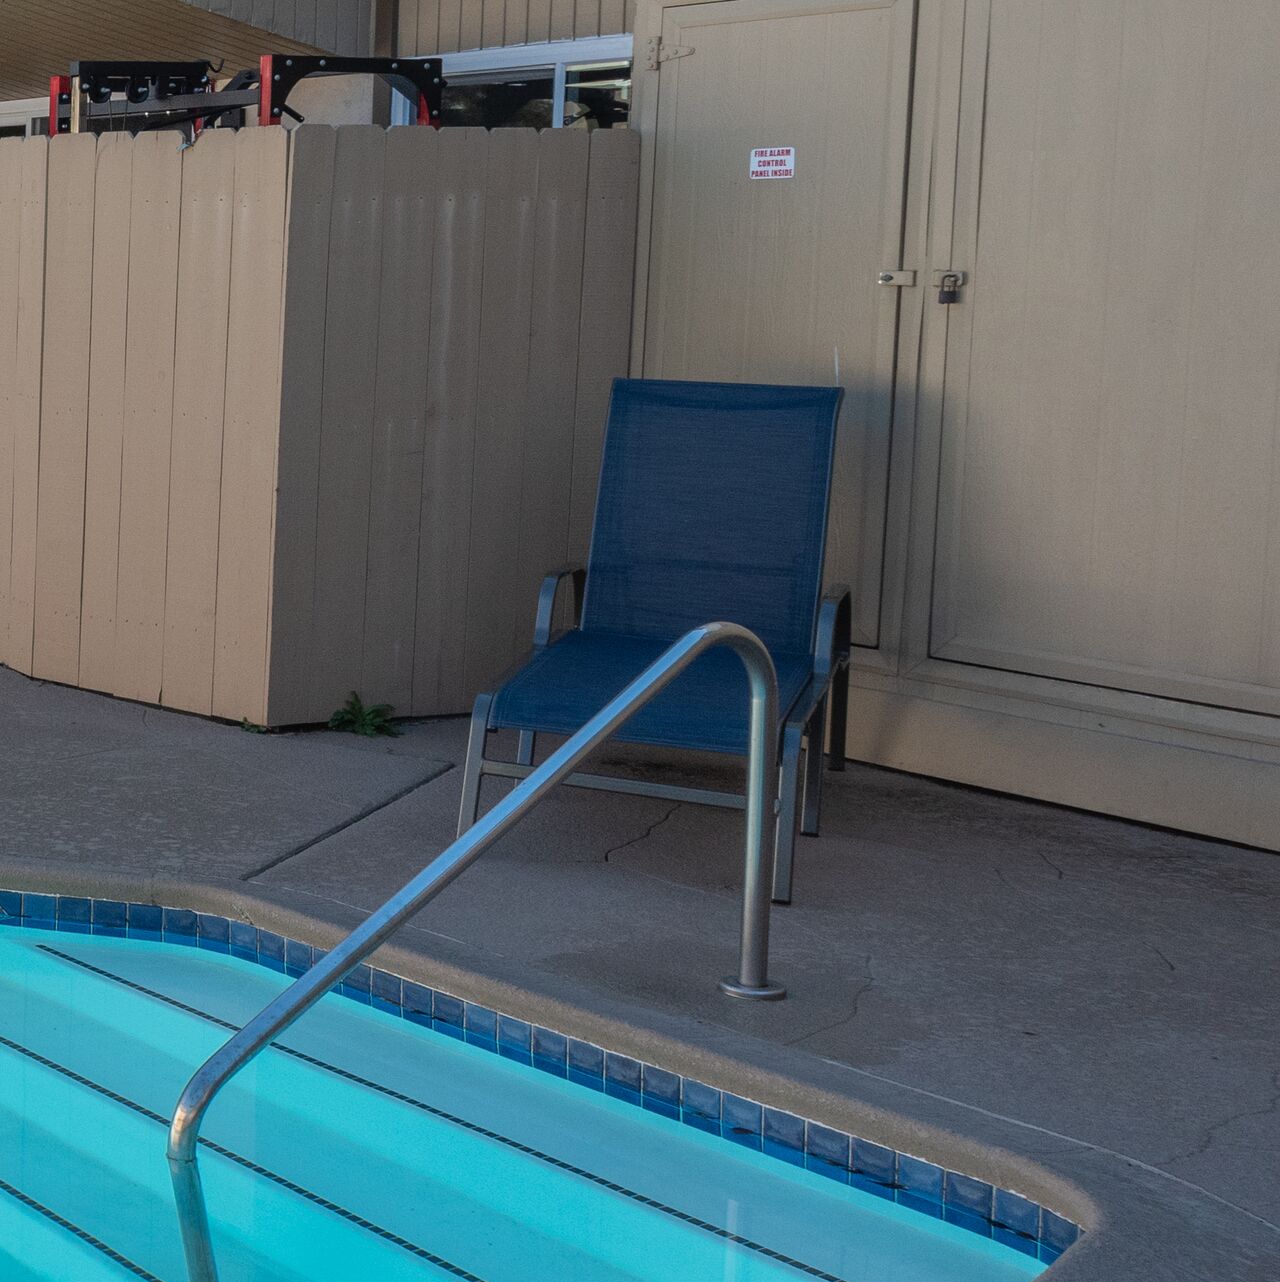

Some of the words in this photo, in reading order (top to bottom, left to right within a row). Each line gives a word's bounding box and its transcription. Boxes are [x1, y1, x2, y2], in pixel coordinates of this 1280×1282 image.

[754, 149, 768, 157] FIRE
[769, 149, 791, 157] ALARM
[751, 169, 770, 177] PANEL
[771, 169, 793, 177] INSIDE
